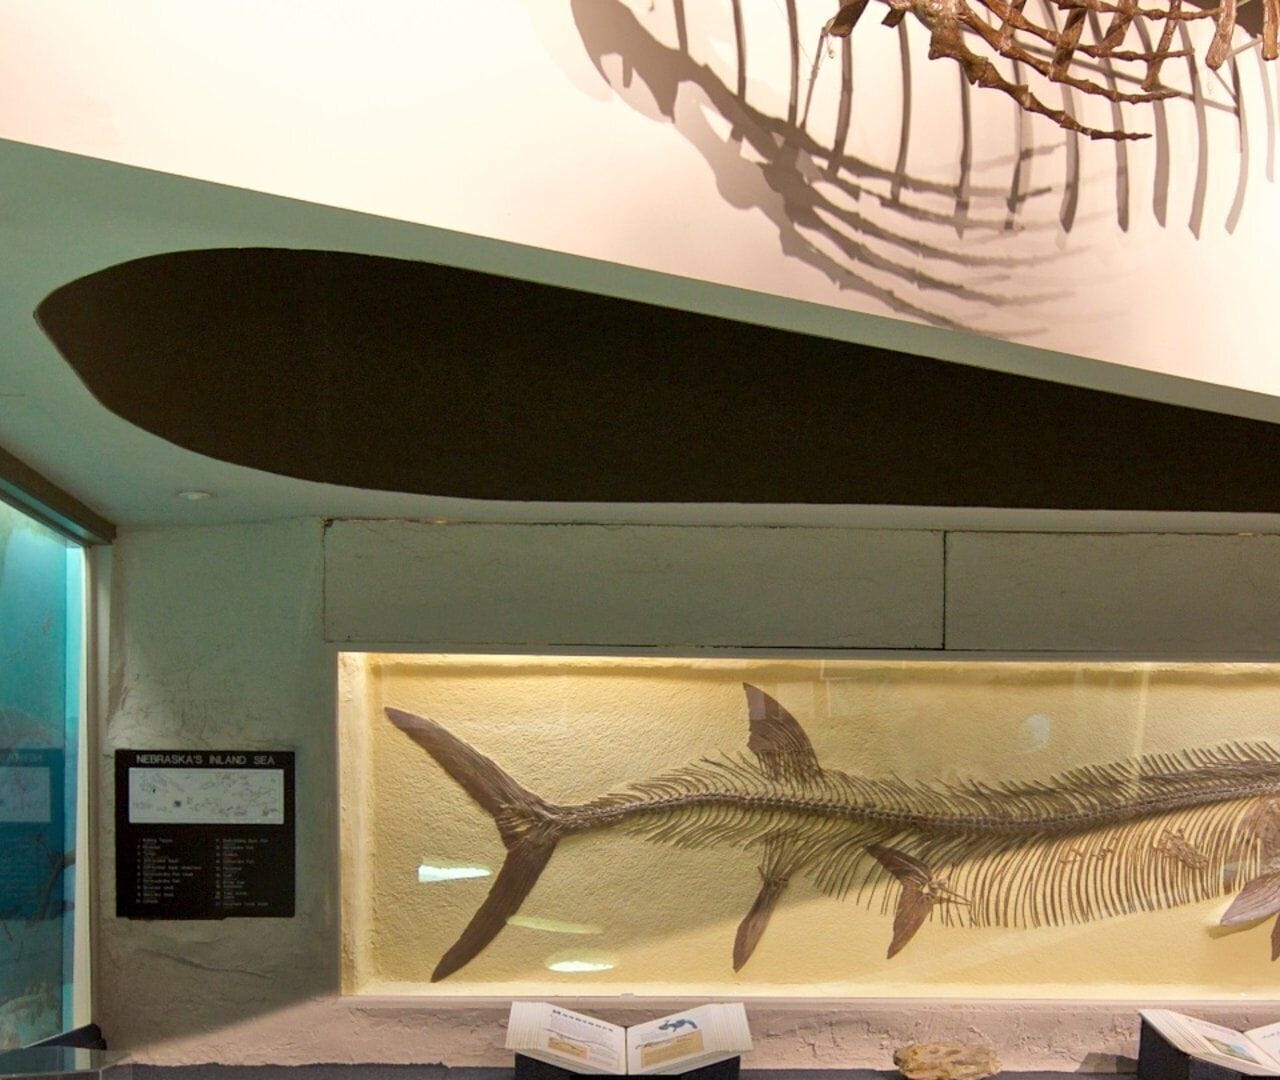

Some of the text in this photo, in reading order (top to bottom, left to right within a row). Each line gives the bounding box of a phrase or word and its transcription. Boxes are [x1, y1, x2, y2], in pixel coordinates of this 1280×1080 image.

[136, 755, 275, 765] NEBRASKA'S INLAND SEA
